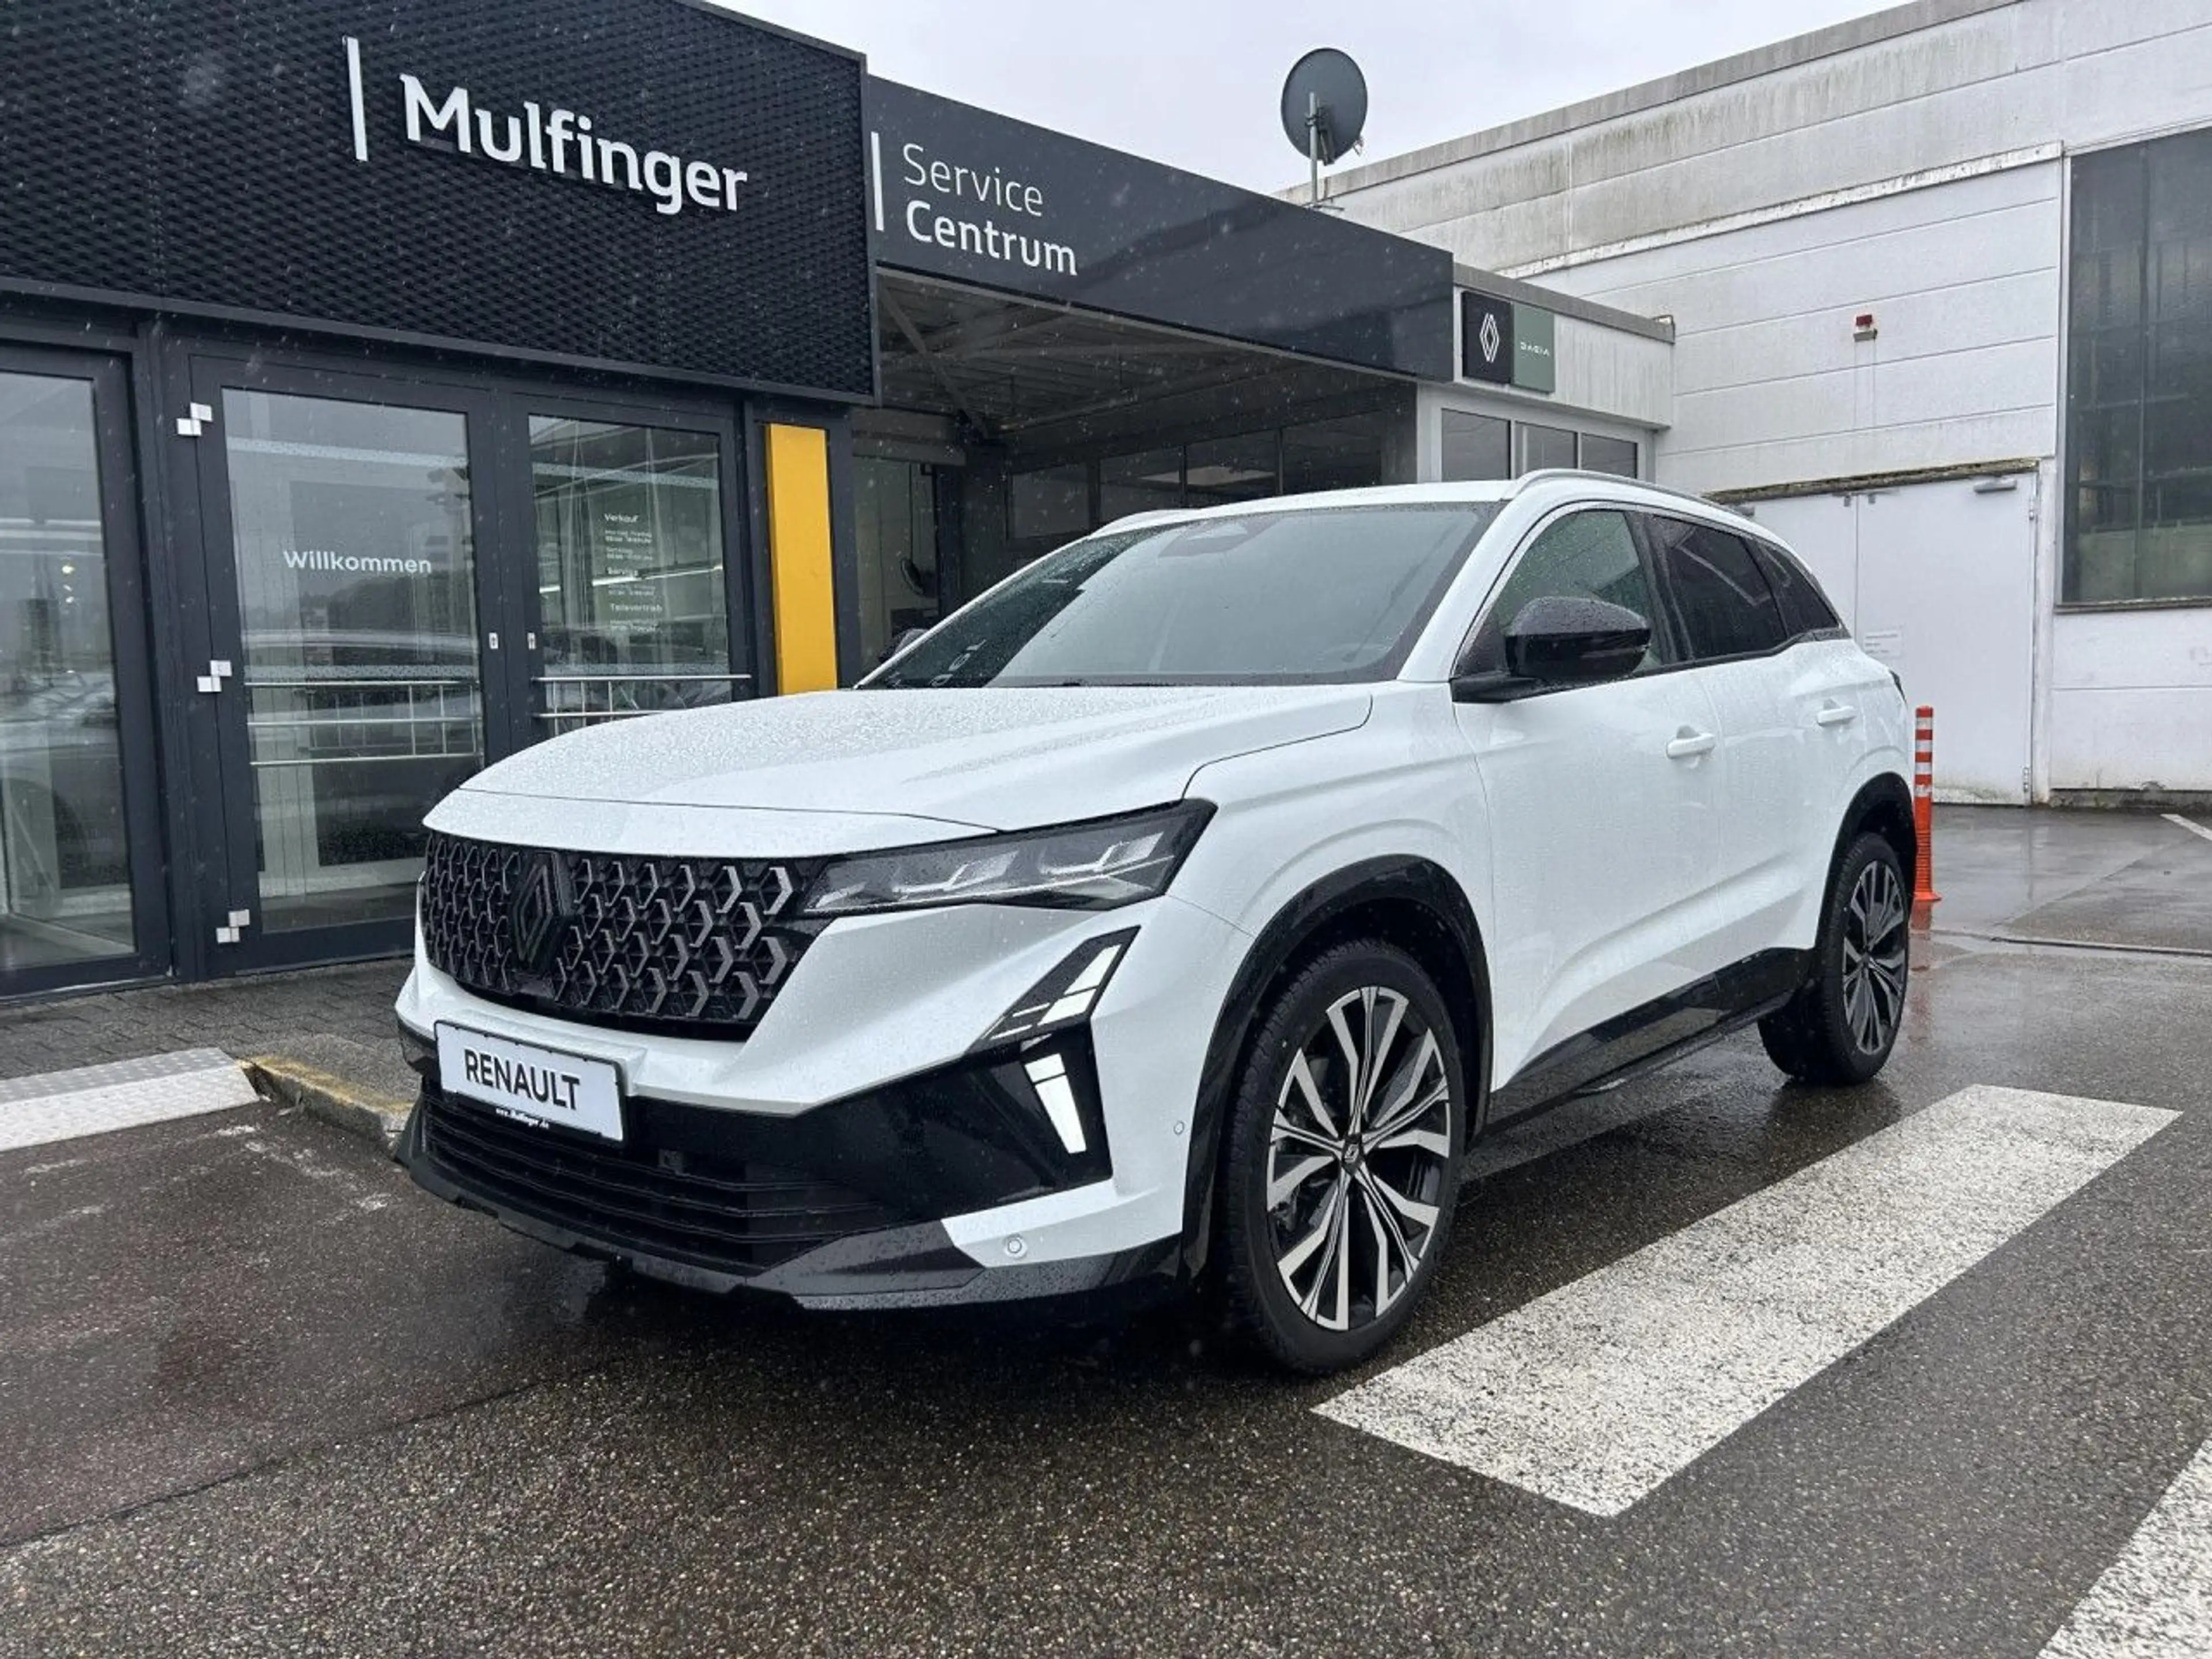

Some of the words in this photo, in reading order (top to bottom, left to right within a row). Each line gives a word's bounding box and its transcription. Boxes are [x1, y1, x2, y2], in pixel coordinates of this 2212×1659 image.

[400, 73, 747, 215] Mulfinger
[903, 143, 1043, 217] Service
[907, 200, 1077, 275] Centrum
[283, 551, 432, 574] Willkommen
[465, 1049, 579, 1110] RENAULT
